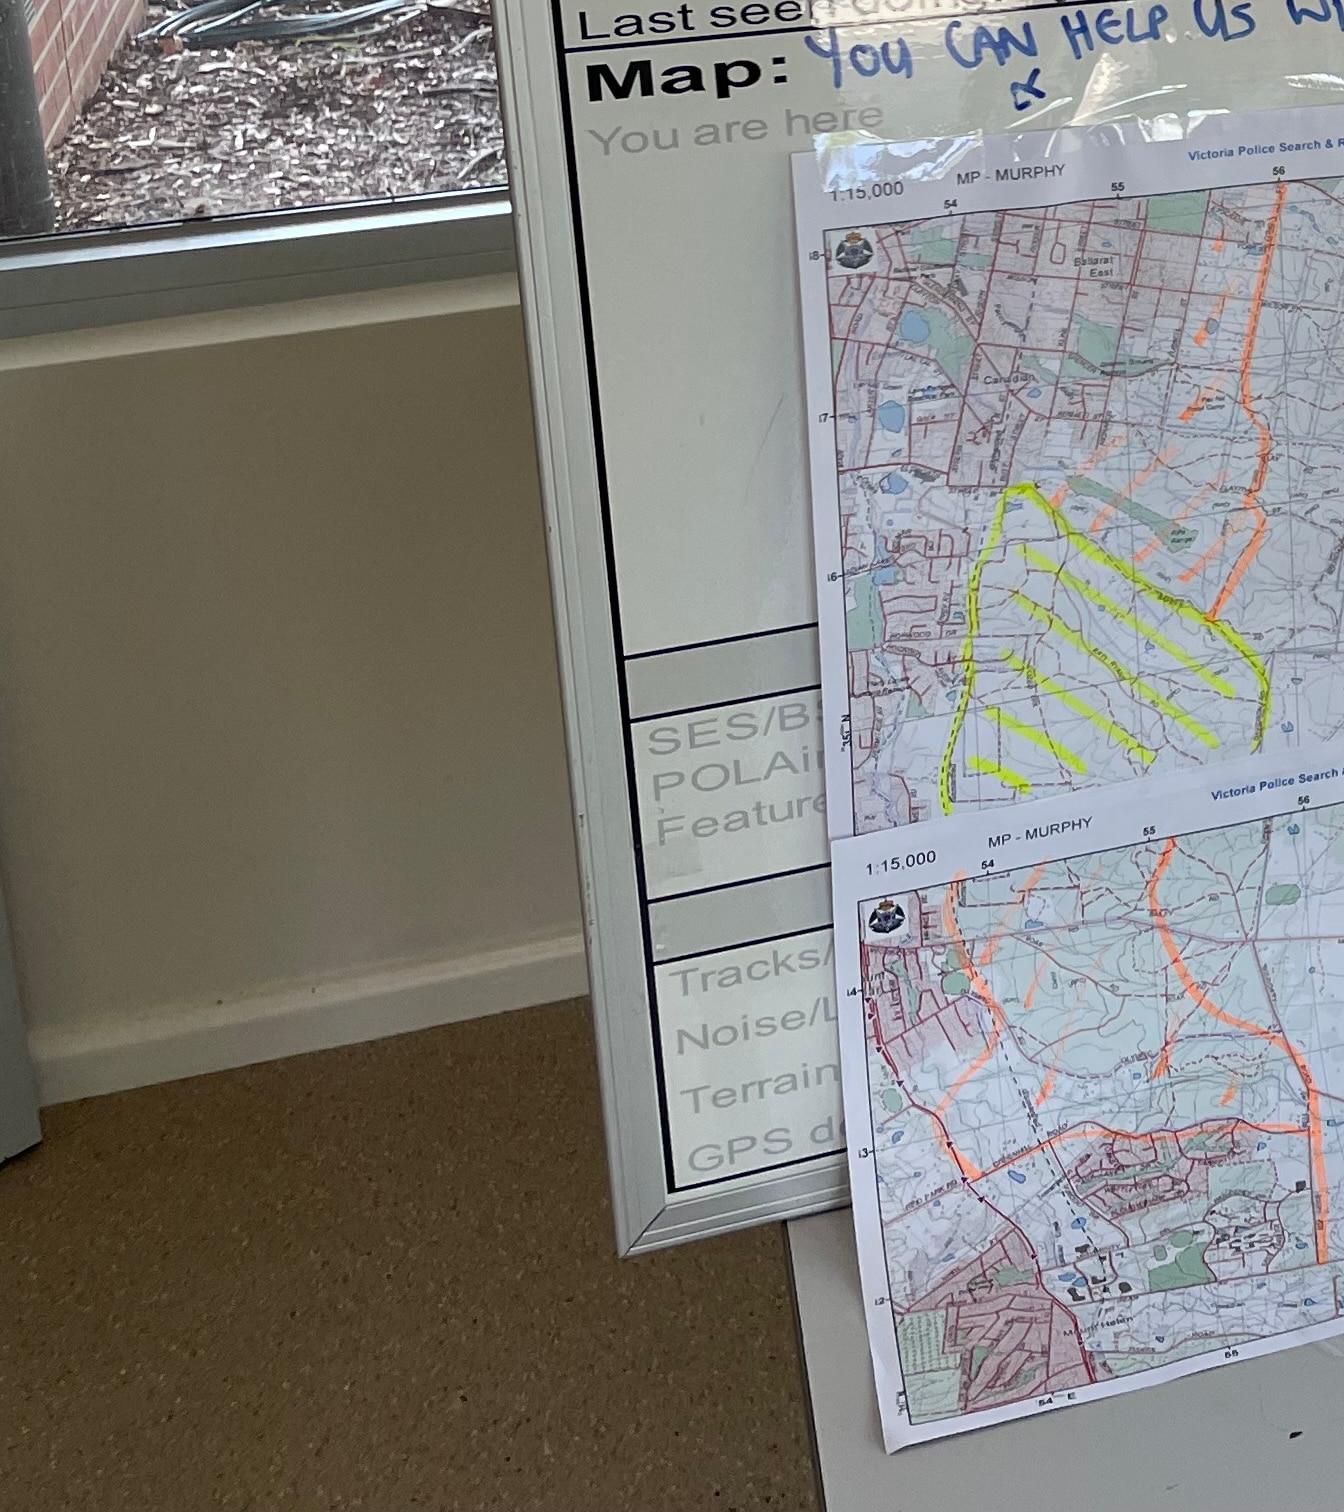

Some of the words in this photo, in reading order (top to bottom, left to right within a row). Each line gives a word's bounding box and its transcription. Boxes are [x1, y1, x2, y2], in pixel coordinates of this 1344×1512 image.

[579, 3, 695, 40] Last
[945, 18, 1038, 68] CAN
[1060, 3, 1169, 59] HELP
[585, 55, 789, 101] Map:
[588, 126, 680, 157] You
[694, 117, 768, 145] are
[785, 105, 884, 138] here
[1188, 147, 1235, 162] Victoria
[1238, 144, 1276, 157] Police
[1279, 139, 1322, 152] Search
[957, 172, 981, 186] MP
[995, 164, 1066, 183] MURPHY
[1211, 784, 1256, 802] Victoria
[1259, 775, 1295, 792] Police
[1298, 767, 1339, 785] Search
[987, 833, 1012, 849] MP
[1025, 815, 1094, 841] MURPHY
[687, 1126, 793, 1173] GPS
